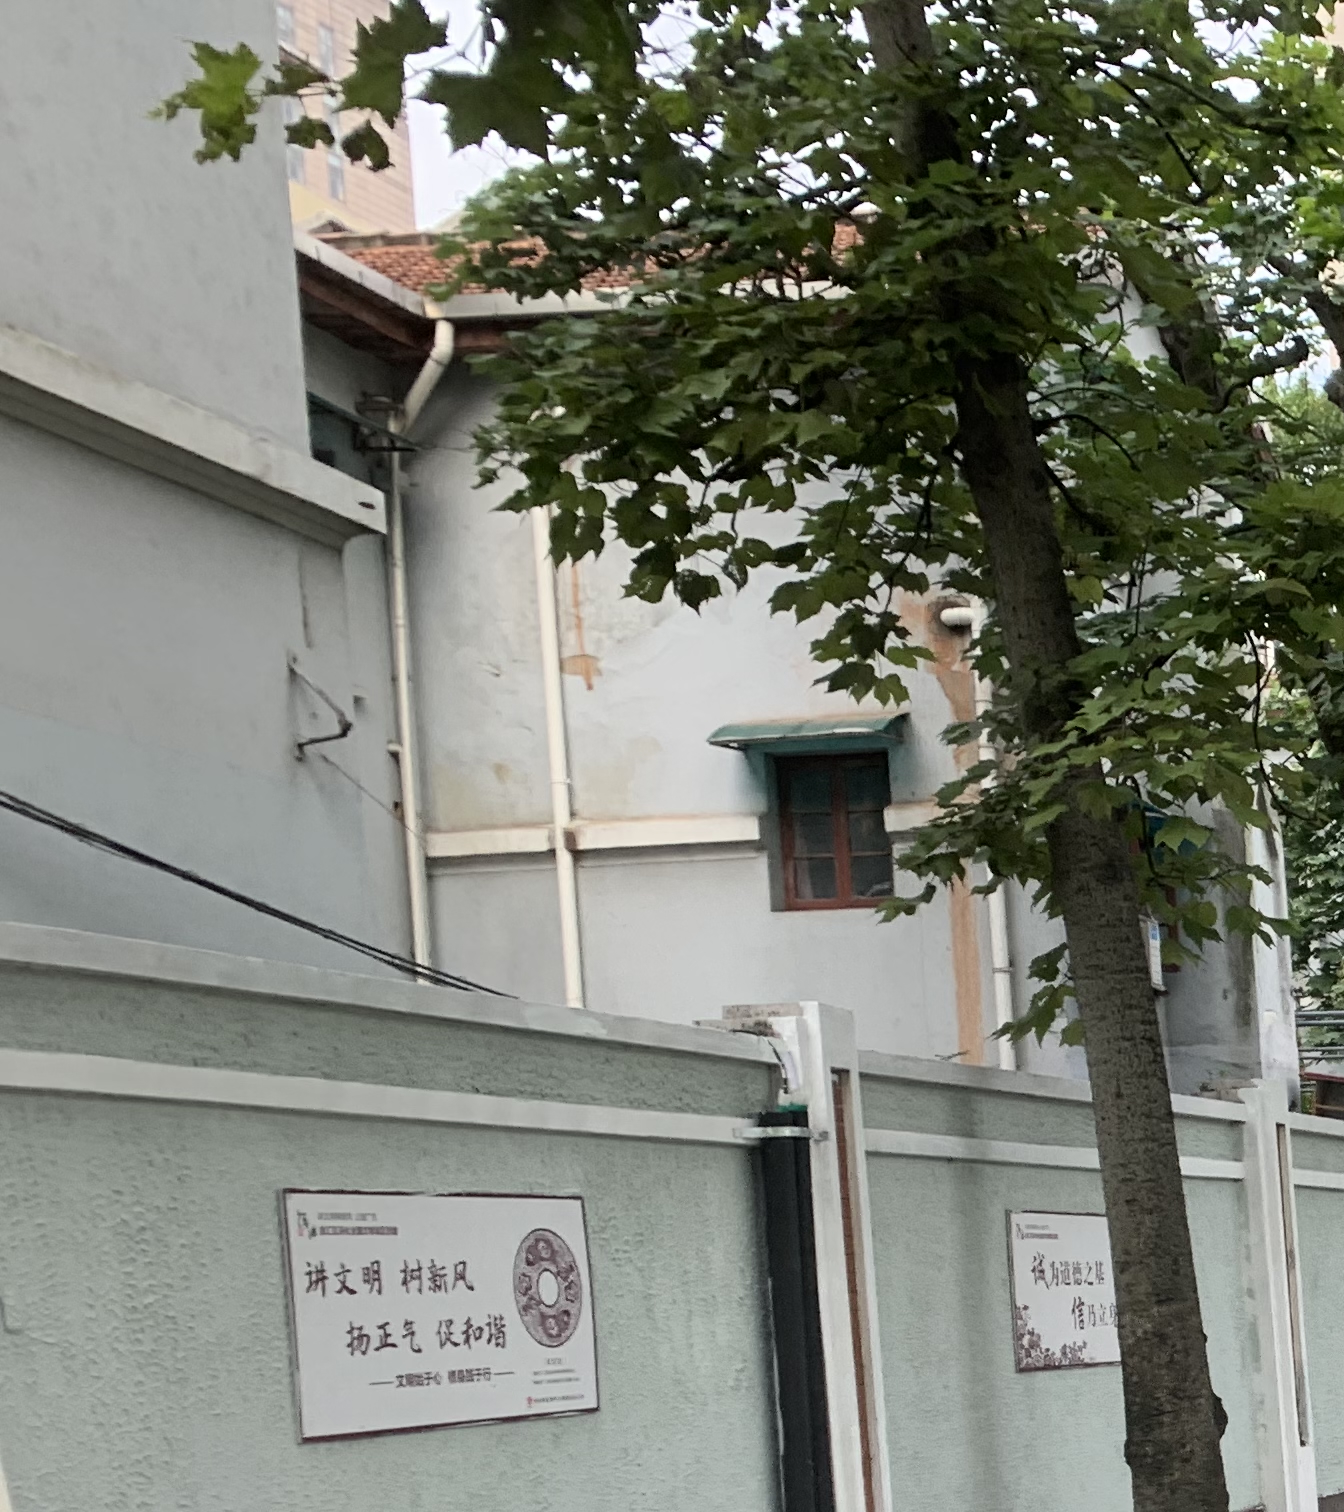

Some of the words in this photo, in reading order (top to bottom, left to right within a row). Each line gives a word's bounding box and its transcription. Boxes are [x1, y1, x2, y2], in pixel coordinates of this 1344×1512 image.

[304, 1260, 383, 1297] 讲文明
[400, 1259, 474, 1294] 树新风
[346, 1319, 423, 1356] 扬正气
[435, 1314, 507, 1350] 促和谐
